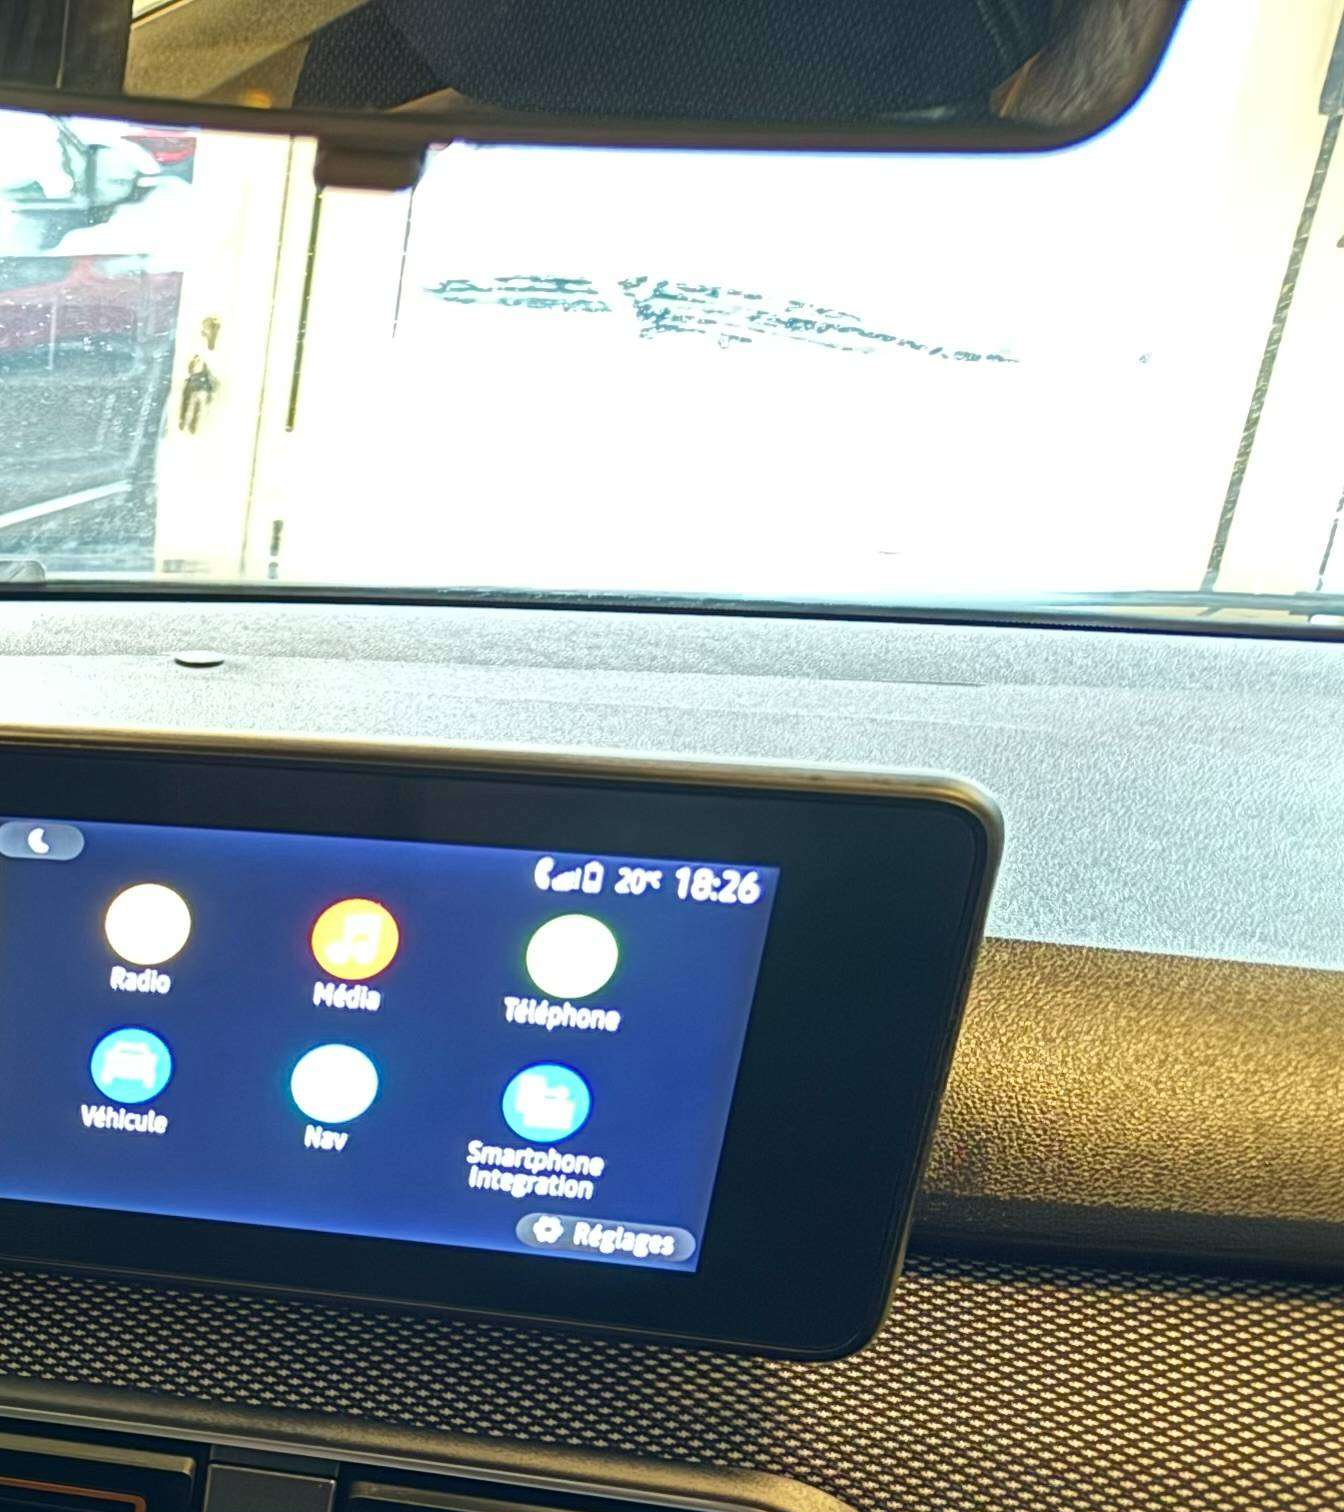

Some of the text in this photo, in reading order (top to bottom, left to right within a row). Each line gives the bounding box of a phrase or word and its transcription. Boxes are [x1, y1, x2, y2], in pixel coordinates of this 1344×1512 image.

[675, 866, 761, 904] 18:26
[110, 966, 171, 994] Radio
[312, 981, 381, 1011] Média
[504, 996, 621, 1032] Téléphone
[81, 1104, 169, 1134] Véhicule
[303, 1124, 349, 1151] Nav
[466, 1139, 605, 1177] Smartphone
[468, 1165, 594, 1201] Integration
[573, 1221, 675, 1258] Réglages
